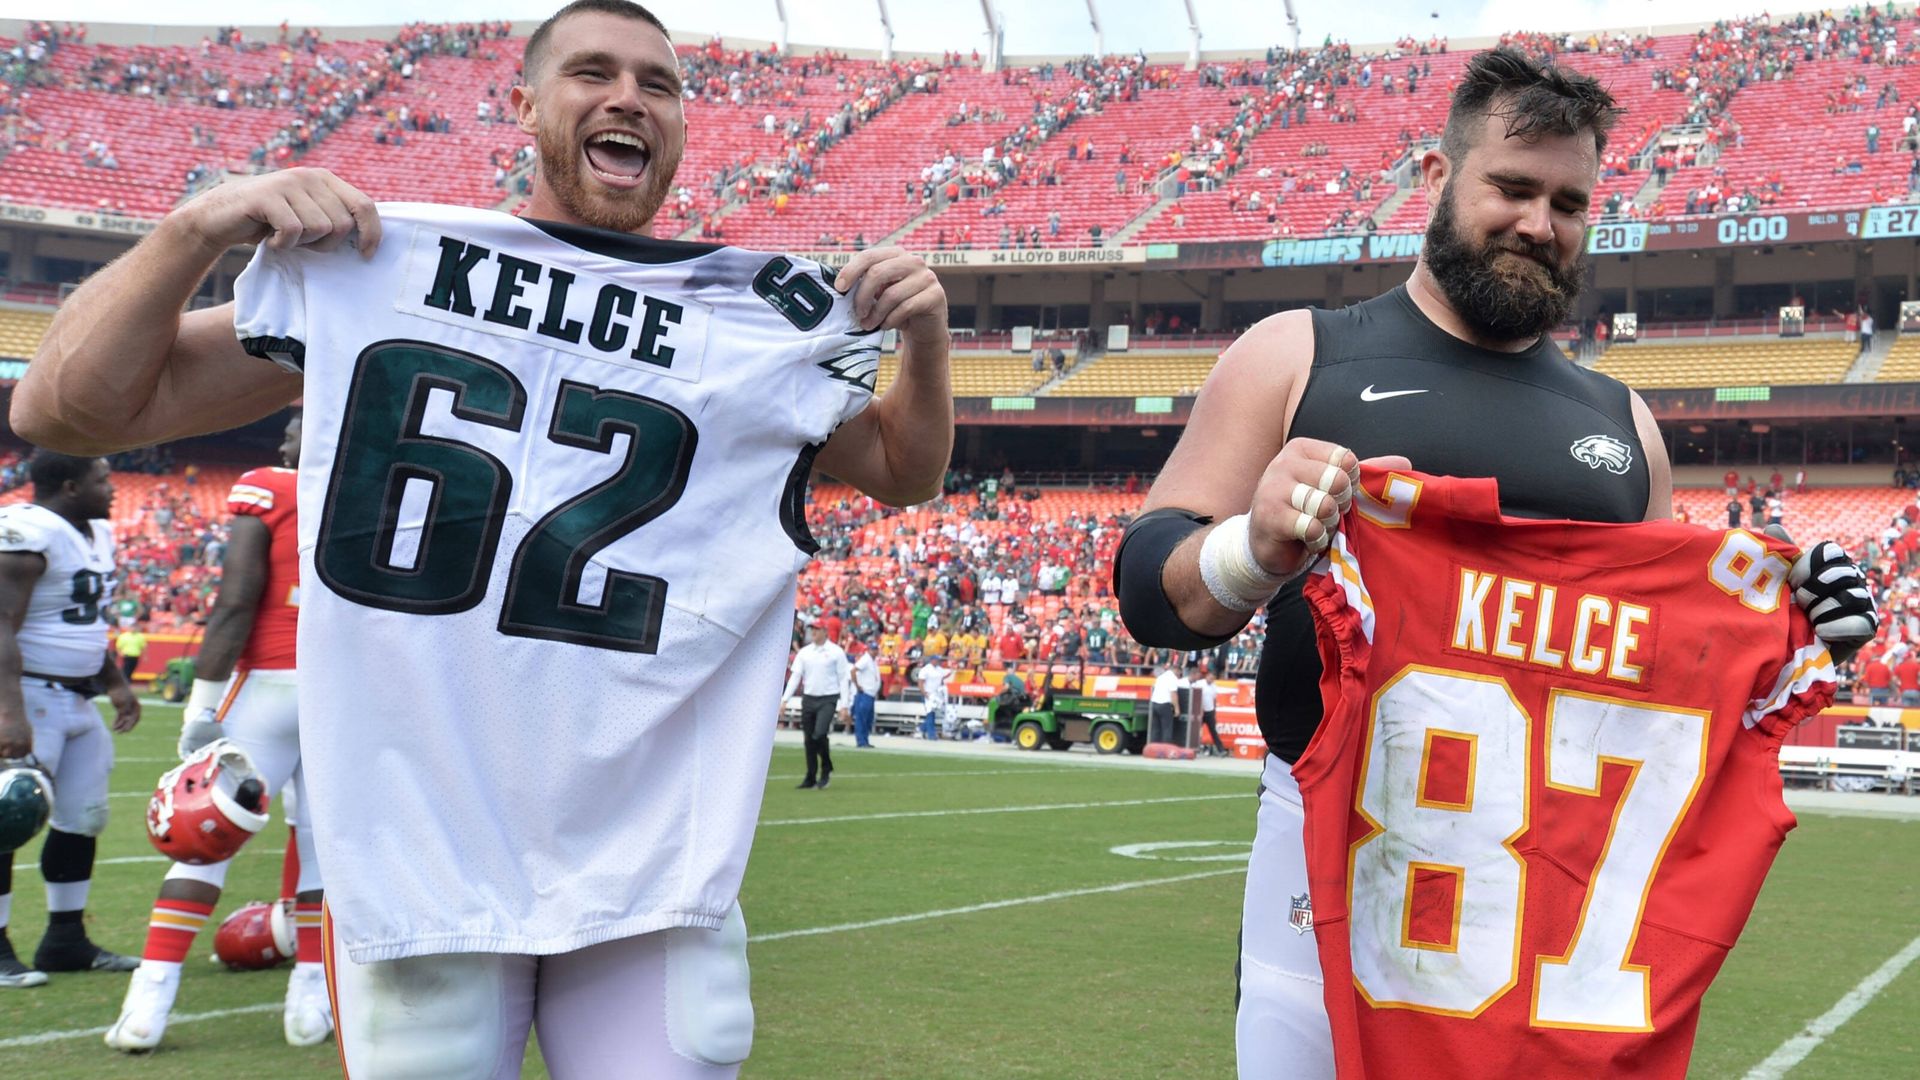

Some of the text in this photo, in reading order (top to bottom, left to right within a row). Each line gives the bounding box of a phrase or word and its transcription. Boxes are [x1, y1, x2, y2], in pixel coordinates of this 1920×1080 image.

[1717, 215, 1789, 244] 0:00
[1888, 209, 1919, 233] 27
[1261, 238, 1363, 267] CHIEFS
[1369, 234, 1425, 259] WIN
[1596, 228, 1626, 250] 20
[932, 252, 968, 264] STILL
[992, 250, 1124, 263] 34 LLOYD BURRUSS
[424, 236, 684, 369] KELCE
[315, 338, 699, 655] 62
[1451, 567, 1651, 684] KELCE
[1215, 722, 1262, 736] GATORA
[1347, 663, 1713, 1033] 87
[1293, 909, 1312, 927] NFL
